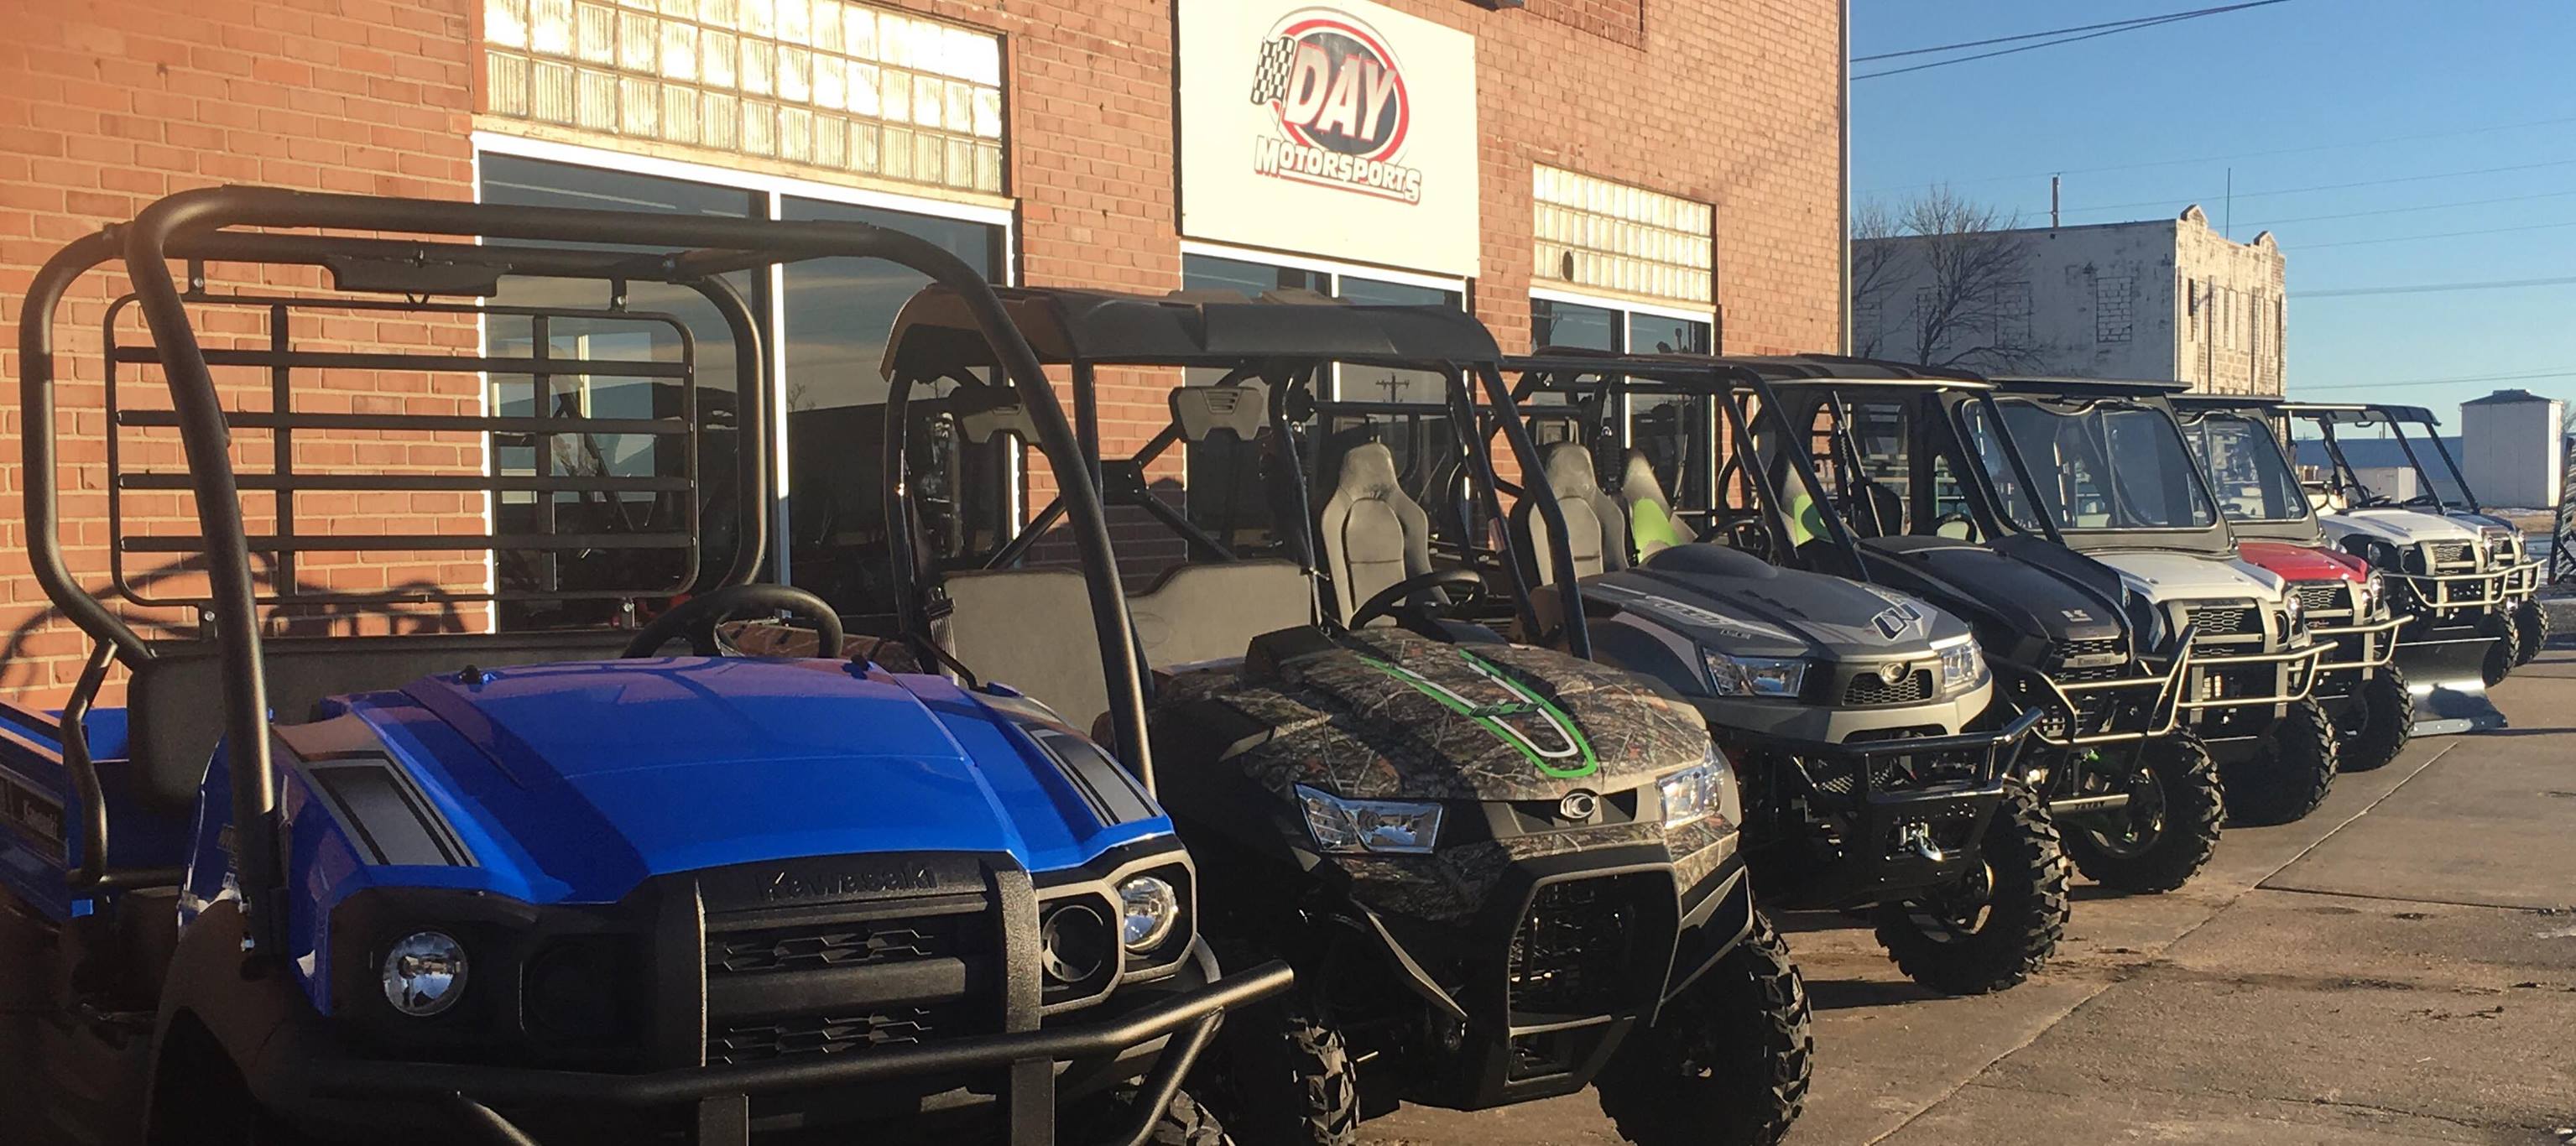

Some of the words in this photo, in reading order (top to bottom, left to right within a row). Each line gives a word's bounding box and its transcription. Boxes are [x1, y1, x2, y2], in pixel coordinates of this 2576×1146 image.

[1283, 42, 1396, 143] DAY
[1254, 135, 1421, 206] MOTORSPORTS
[756, 863, 941, 903] Kawasaki
